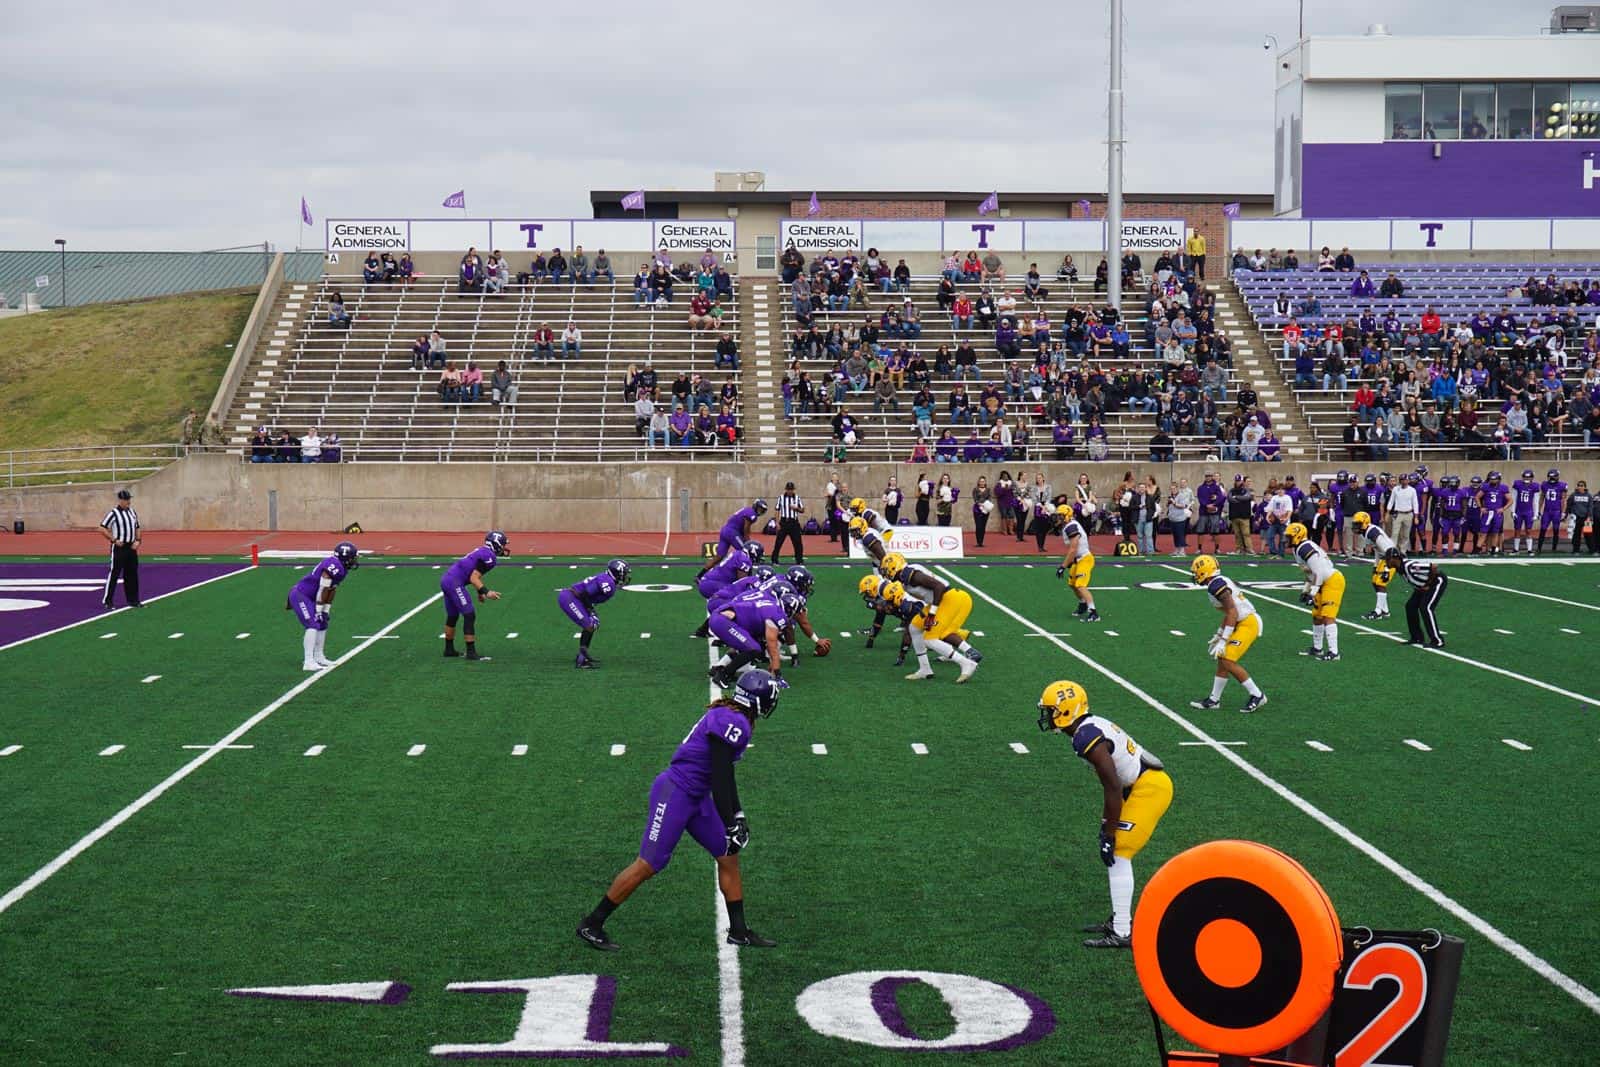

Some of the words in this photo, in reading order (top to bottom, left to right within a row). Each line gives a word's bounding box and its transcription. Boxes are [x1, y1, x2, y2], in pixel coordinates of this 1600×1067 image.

[335, 224, 401, 236] GENERAL
[519, 223, 543, 248] T
[661, 224, 728, 236] GENERAL
[788, 224, 854, 236] GENERAL
[971, 224, 995, 248] T
[1419, 223, 1443, 247] T
[331, 237, 406, 248] ADMISSION
[658, 237, 732, 248] ADMISSION
[785, 237, 859, 248] ADMISSION
[1120, 238, 1182, 248] DMISSION
[330, 254, 337, 262] A
[725, 253, 732, 262] A
[340, 545, 351, 556] T
[1119, 542, 1138, 556] 20
[327, 563, 339, 575] 24
[794, 570, 804, 581] T
[724, 723, 743, 743] 13
[648, 801, 667, 842] TEXANS
[1335, 942, 1428, 1067] 2
